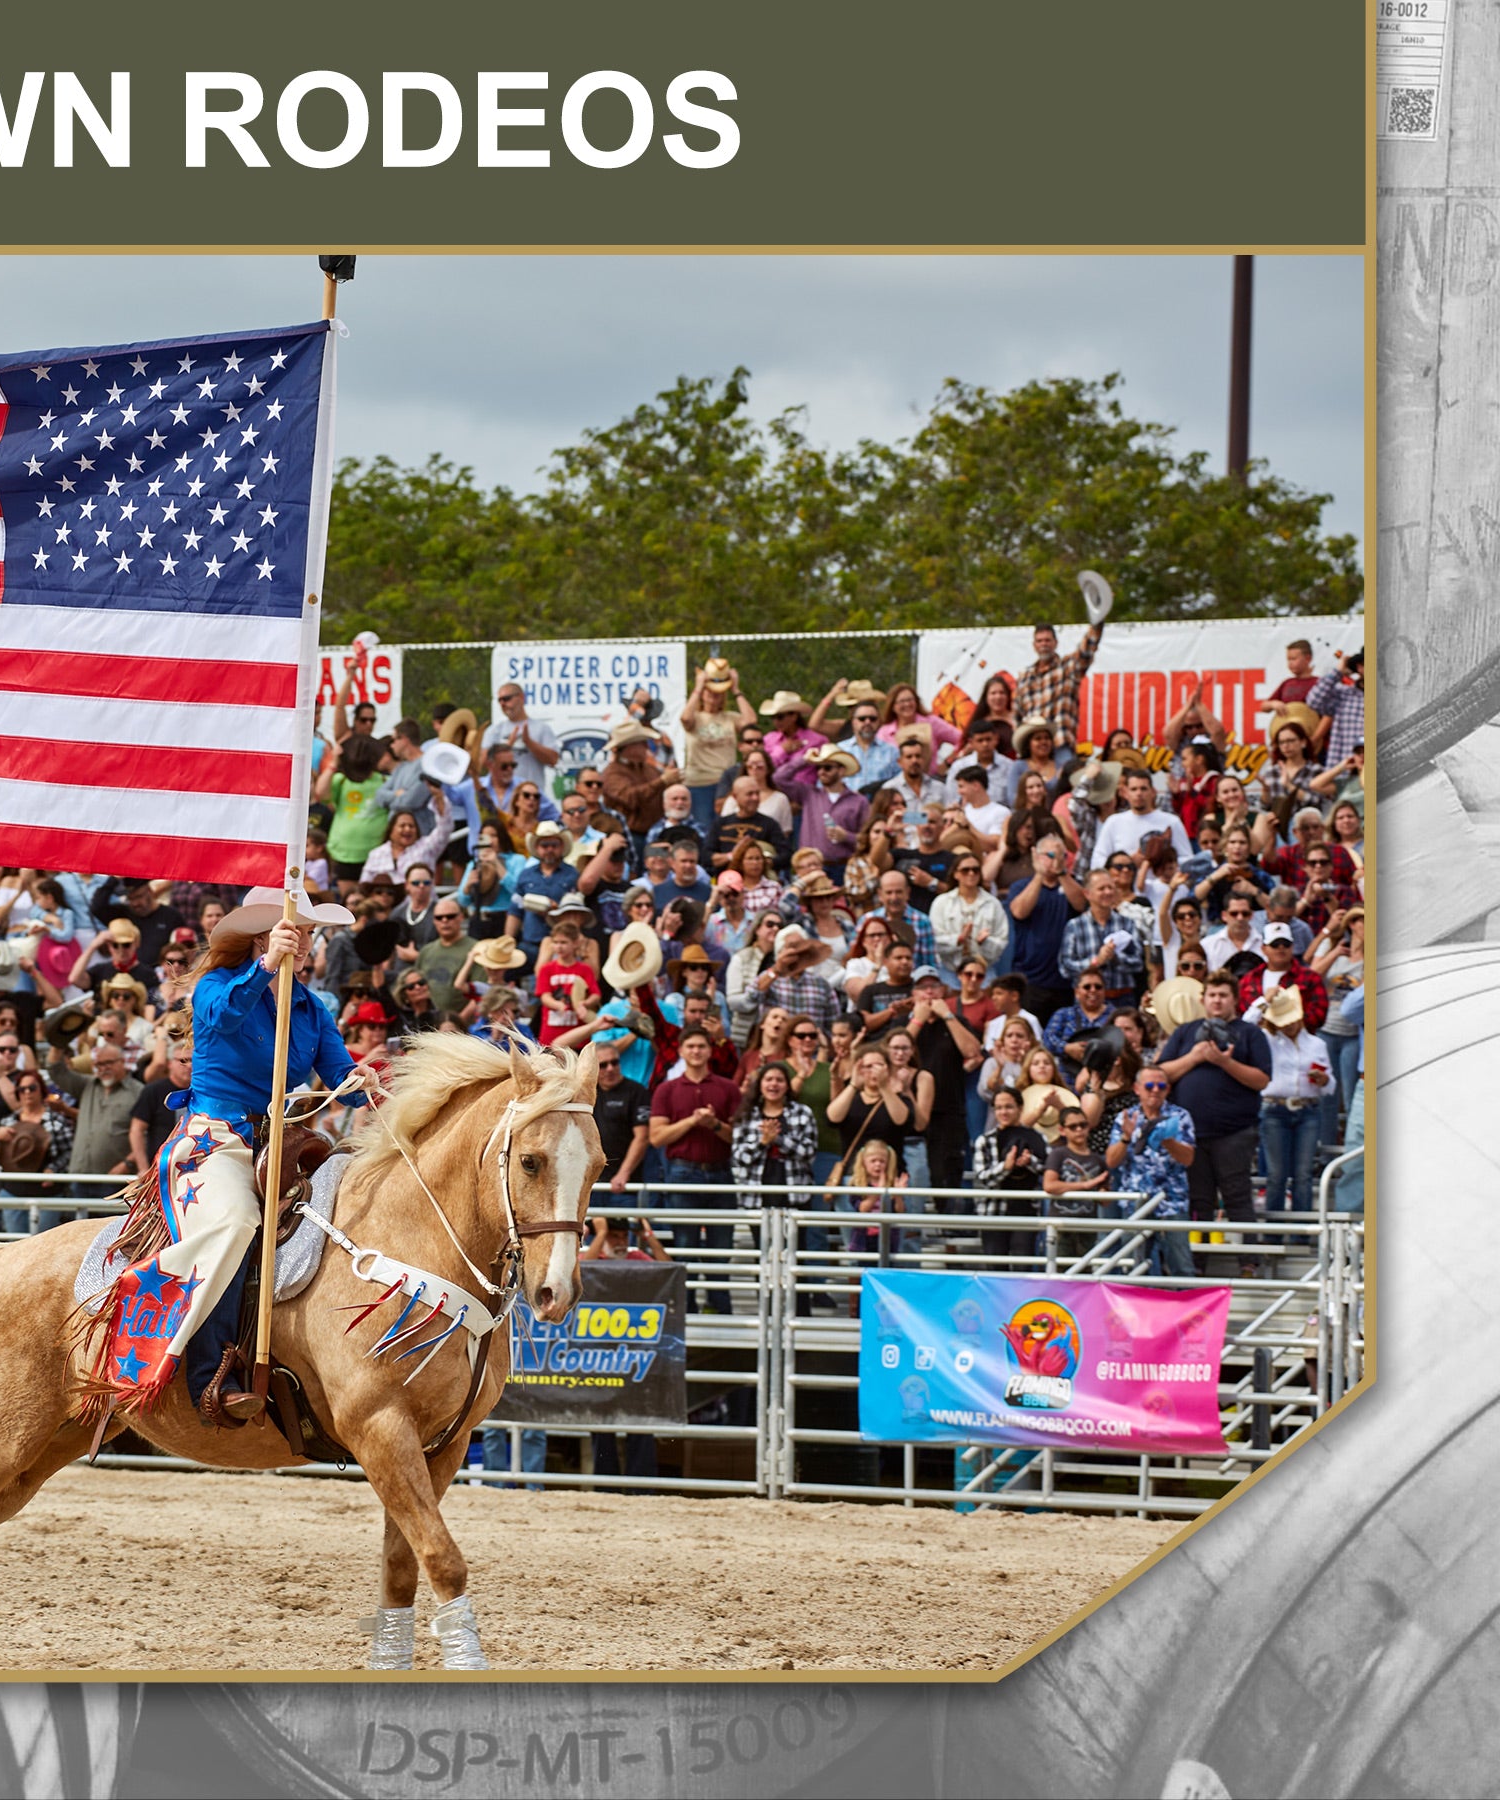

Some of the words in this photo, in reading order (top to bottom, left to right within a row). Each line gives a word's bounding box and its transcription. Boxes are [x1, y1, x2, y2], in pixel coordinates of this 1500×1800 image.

[509, 656, 601, 679] SPITZER
[612, 655, 669, 678] CDJR
[524, 682, 661, 706] HOMESTED
[575, 1307, 661, 1339] 100.3
[548, 1340, 657, 1382] Country
[1095, 1360, 1213, 1383] @FLAMINGOBBQCO
[1006, 1375, 1072, 1403] FLAMINGO
[928, 1408, 1133, 1437] WWW.FLAMINGOBBQCO.COM
[358, 1686, 859, 1790] DSP-MT-15009
